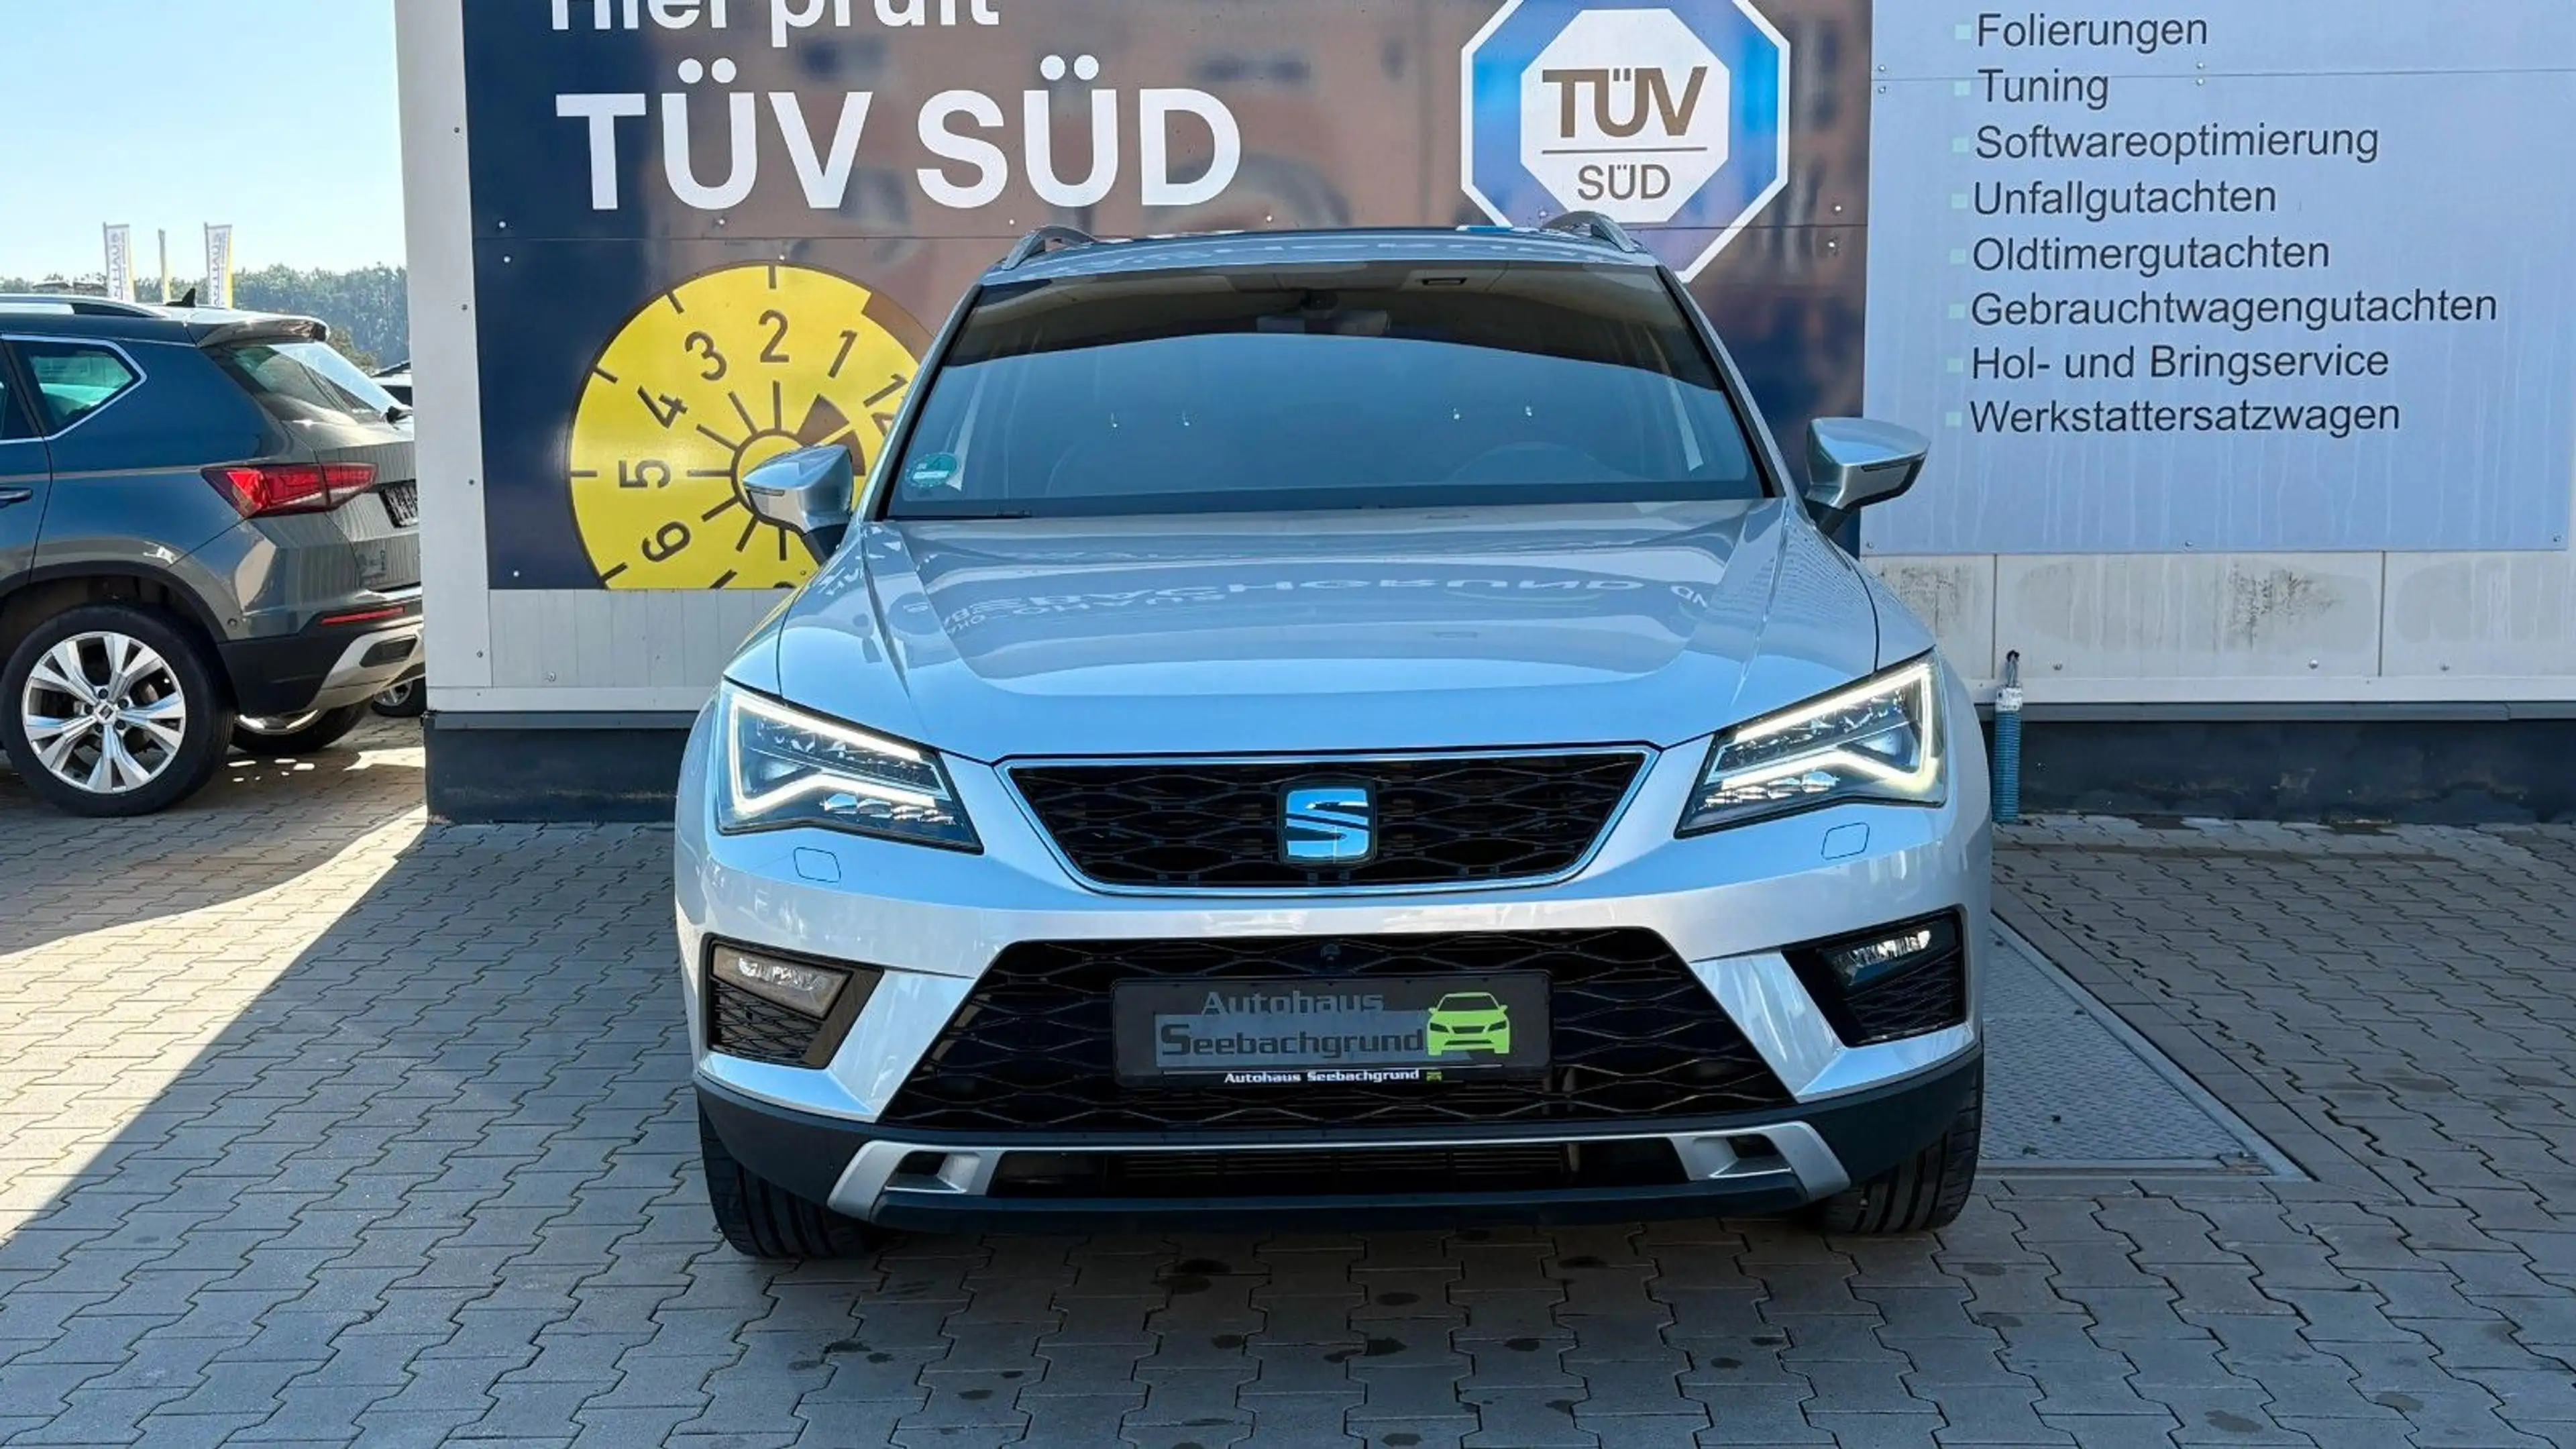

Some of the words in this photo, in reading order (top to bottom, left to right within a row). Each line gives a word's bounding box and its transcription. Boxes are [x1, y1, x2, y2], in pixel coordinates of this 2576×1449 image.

[1979, 13, 2207, 54] Folierungen
[1542, 66, 1707, 138] TÜV
[1978, 68, 2108, 111] Tuning
[556, 58, 873, 210] TÜV
[916, 54, 1241, 209] SÜD
[1976, 123, 2379, 165] Softwareoptimierung
[1577, 164, 1670, 201] SÜD
[1974, 179, 2276, 222] Unfallgutachten
[1973, 235, 2330, 277] Oldtimergutachten
[1972, 288, 2497, 331] Gebrauchtwagengutachten
[684, 331, 727, 381] 3
[759, 309, 790, 363] 2
[827, 330, 857, 379] 1
[1973, 346, 2050, 380] Hol-
[2065, 345, 2135, 379] und
[2151, 343, 2389, 385] Bringservice
[637, 386, 688, 429] 4
[1970, 399, 2400, 438] Werkstattersatzwagen
[618, 460, 671, 489] 5
[641, 521, 691, 563] 6
[1201, 991, 1384, 1016] Autohaus
[1161, 1023, 1424, 1059] Seebachgrund
[1224, 1071, 1302, 1083] Autohaus
[1307, 1069, 1419, 1083] Seebachgrund
